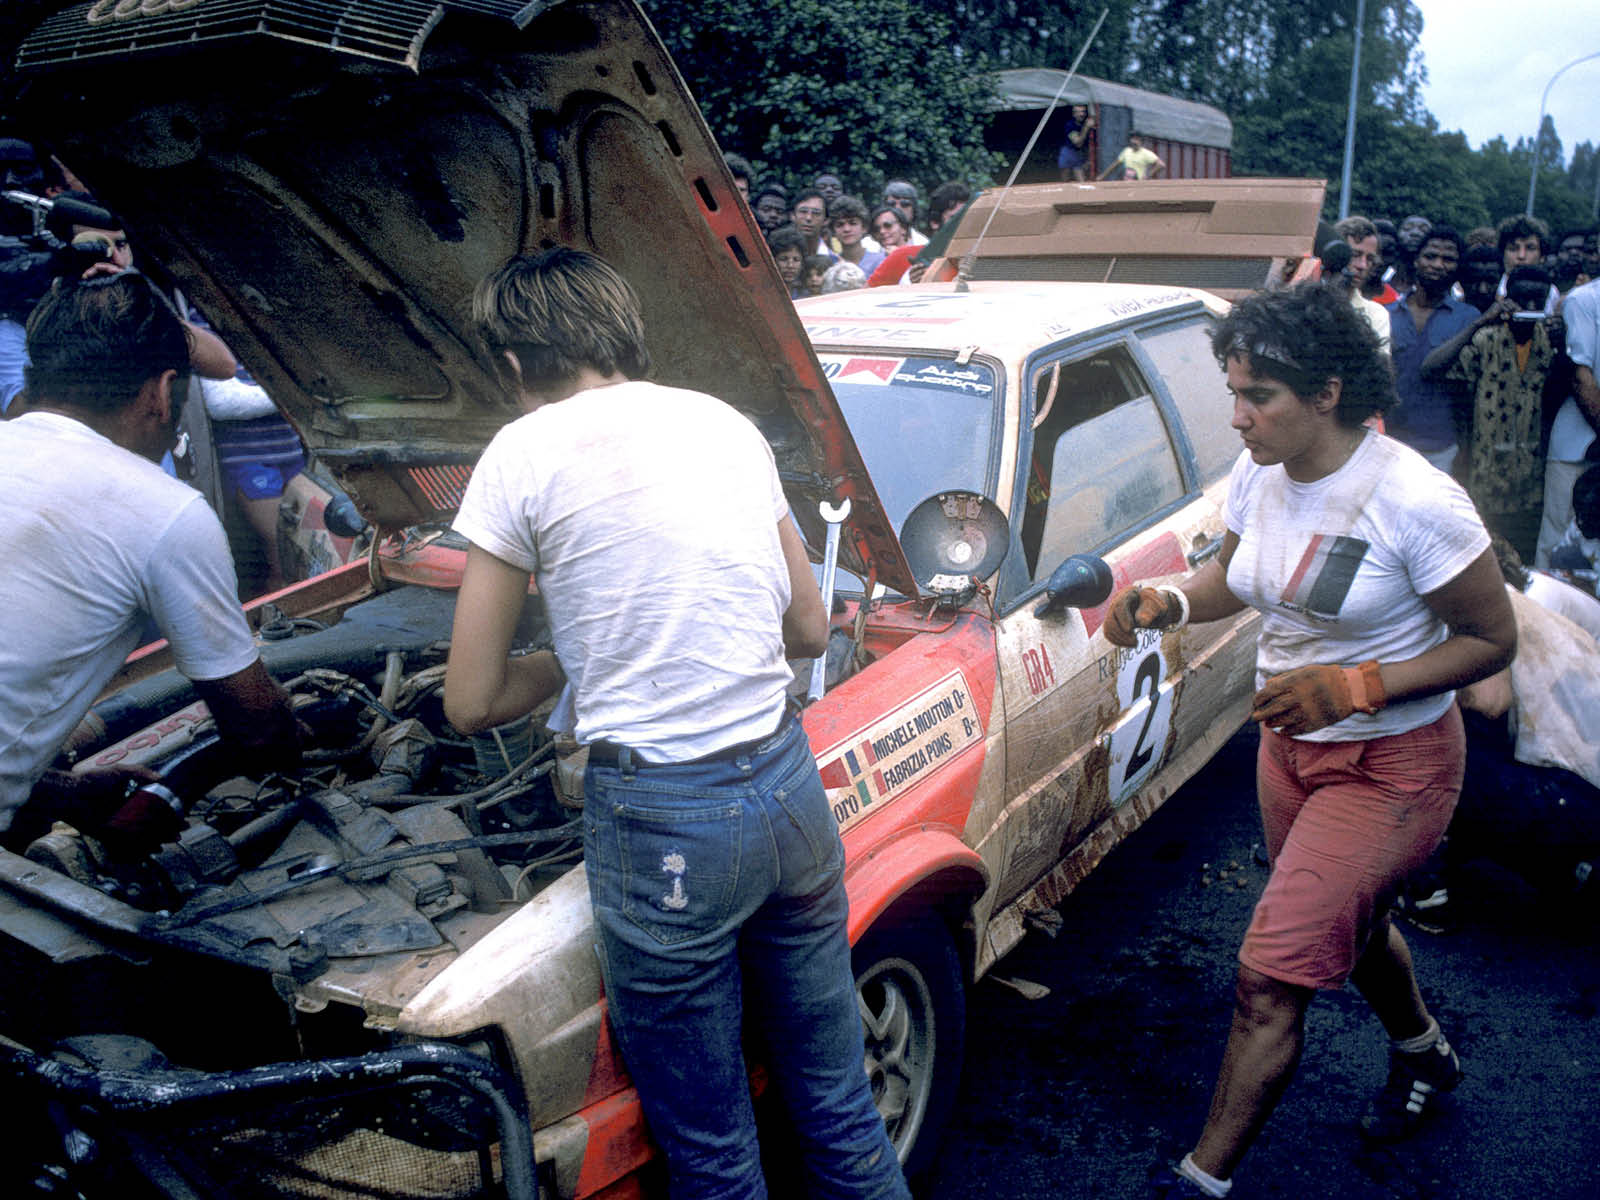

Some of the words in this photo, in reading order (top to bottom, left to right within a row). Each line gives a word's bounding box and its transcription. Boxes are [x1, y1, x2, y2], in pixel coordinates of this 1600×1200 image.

[894, 373, 993, 393] quattro
[918, 364, 980, 381] Audi
[1022, 642, 1056, 697] GR4
[872, 720, 917, 761] MICHELE
[913, 696, 953, 735] MOUTON
[1122, 650, 1161, 785] 2
[882, 748, 929, 791] FABRIZIA
[925, 733, 953, 766] PONS
[962, 716, 977, 738] B+
[833, 794, 859, 824] oro
